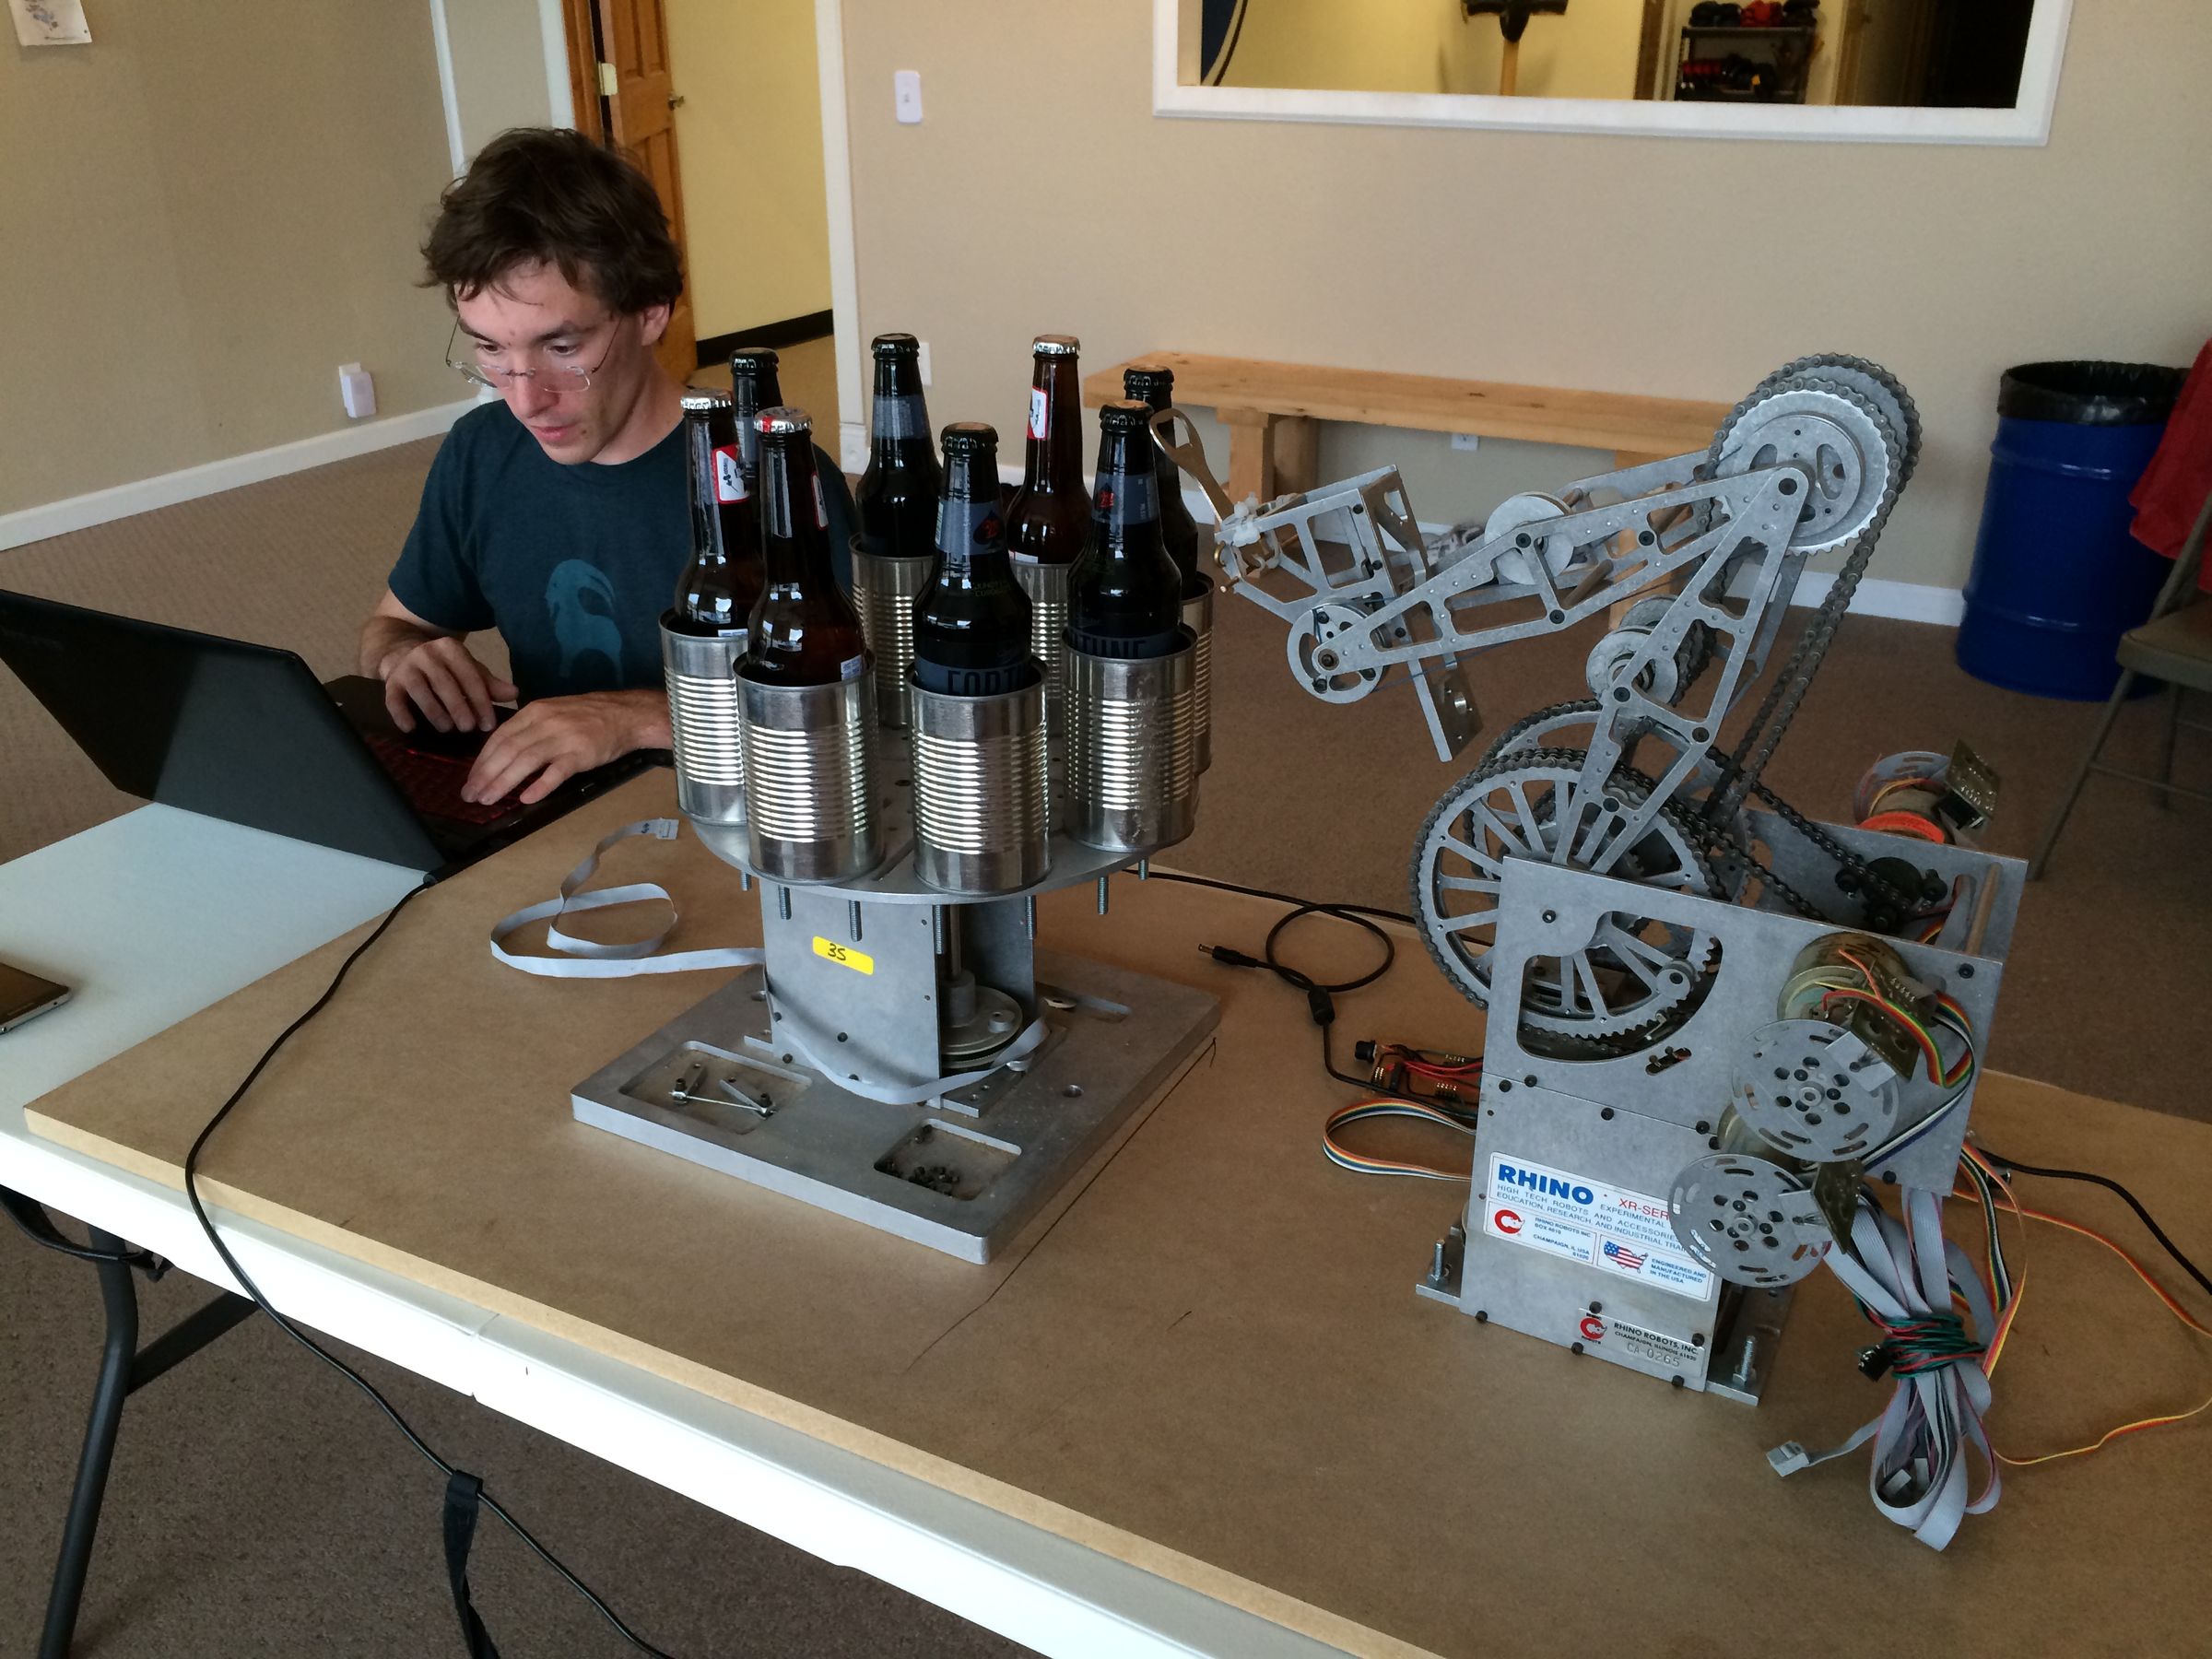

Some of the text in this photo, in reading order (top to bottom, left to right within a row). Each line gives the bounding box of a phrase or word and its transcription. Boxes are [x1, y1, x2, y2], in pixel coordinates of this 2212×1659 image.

[1499, 1164, 1670, 1221] RHINO XR-SER
[1498, 1184, 1677, 1241] HIGH TECH ROBOTS AND ACCESSORIE
[1600, 1204, 1664, 1227] EXPERIMENTAL
[1555, 1222, 1580, 1234] ROBOTS
[1595, 1220, 1612, 1230] AND
[1614, 1226, 1663, 1245] INDUSTRIAL
[1652, 1258, 1692, 1274] ENGINEERED
[1652, 1264, 1702, 1283] MANUFACTURED
[1614, 1323, 1642, 1336] RHINO
